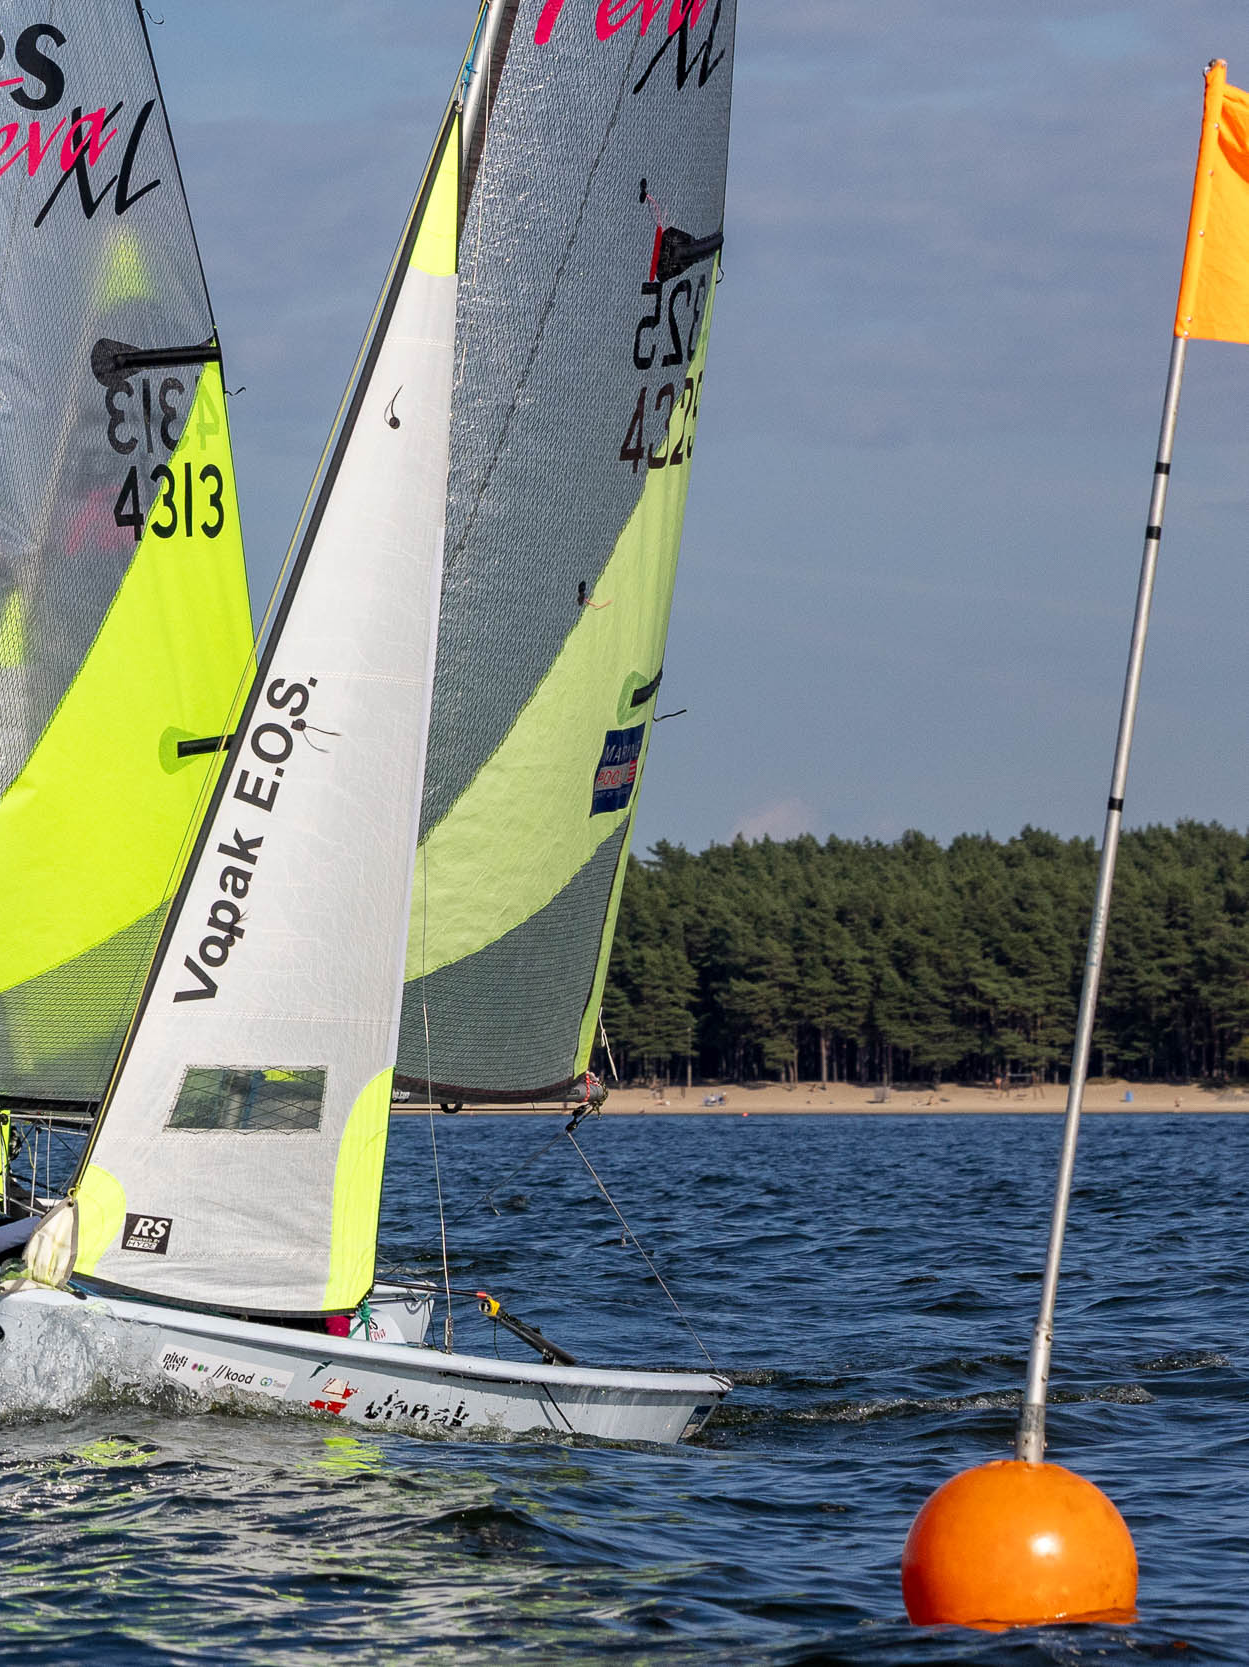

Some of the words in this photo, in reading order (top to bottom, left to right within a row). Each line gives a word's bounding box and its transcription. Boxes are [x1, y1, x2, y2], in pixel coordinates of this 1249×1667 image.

[34, 100, 161, 227] XL
[113, 462, 224, 541] 4313
[173, 827, 264, 1003] Vopak
[233, 676, 318, 812] E.O.S.
[132, 1217, 169, 1238] RS
